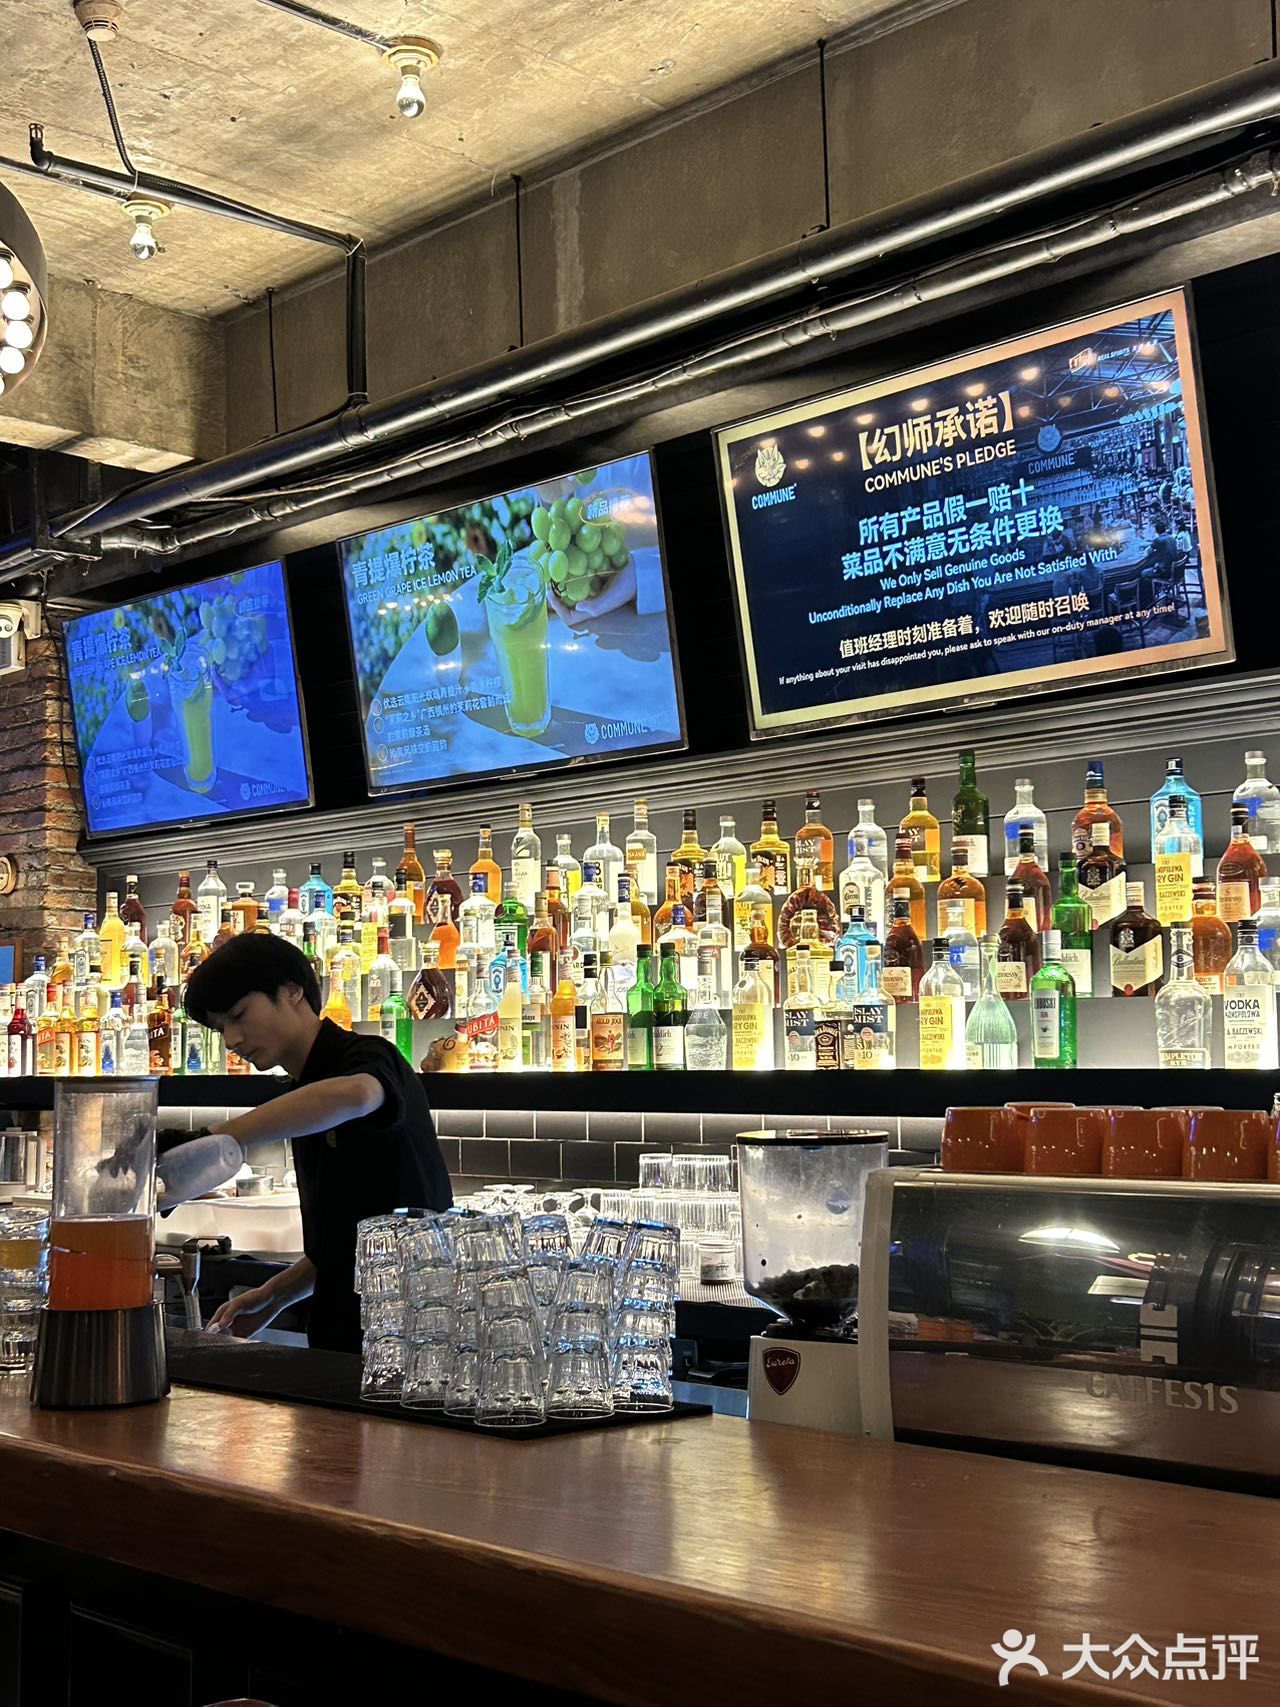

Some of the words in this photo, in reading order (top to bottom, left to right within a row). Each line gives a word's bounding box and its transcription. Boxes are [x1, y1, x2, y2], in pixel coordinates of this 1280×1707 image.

[858, 390, 1014, 471] 【幻师承诺】
[864, 457, 954, 493] COMMUNE'S
[956, 439, 1017, 469] PLEDGE
[1028, 451, 1077, 475] COMMUNE
[752, 485, 796, 510] COMMUNE
[858, 477, 1036, 546] 所有产品假一赔十
[841, 504, 1064, 581] 菜品不满意无条件更换
[357, 589, 384, 605] GREEN
[384, 582, 412, 597] GRAPE
[413, 577, 427, 590] ICE
[427, 570, 460, 587] LEMON
[460, 565, 478, 579] TEA
[808, 599, 882, 625] Unconditionally
[883, 590, 923, 609] Replace
[924, 586, 945, 601] Any
[947, 579, 970, 596] Dish
[971, 576, 993, 590] You
[994, 570, 1013, 585] Are
[1015, 565, 1036, 581] Not
[1037, 552, 1088, 577] Satisfied
[1089, 547, 1118, 564] With
[880, 578, 898, 591] We
[899, 572, 922, 588] Only
[924, 566, 943, 582] Sell
[944, 557, 988, 579] Genuine
[990, 548, 1026, 569] Goods
[785, 672, 814, 685] anything
[815, 667, 835, 678] about
[835, 665, 851, 677] your
[852, 661, 867, 672] visit
[867, 659, 880, 669] has
[880, 650, 927, 667] disappointed
[927, 647, 944, 660] you,
[944, 642, 968, 656] please
[969, 638, 982, 649] ask
[983, 638, 992, 648] to
[993, 633, 1017, 646] speak
[1017, 628, 1036, 640] with
[1036, 627, 1051, 637] our
[1051, 620, 1085, 634] on-duty
[1086, 614, 1123, 628] manager
[1124, 611, 1134, 620] at
[1135, 609, 1152, 619] any
[1152, 602, 1175, 615] time!
[1167, 873, 1184, 883] GIN
[744, 1022, 758, 1031] GIN
[928, 1016, 944, 1025] GIN
